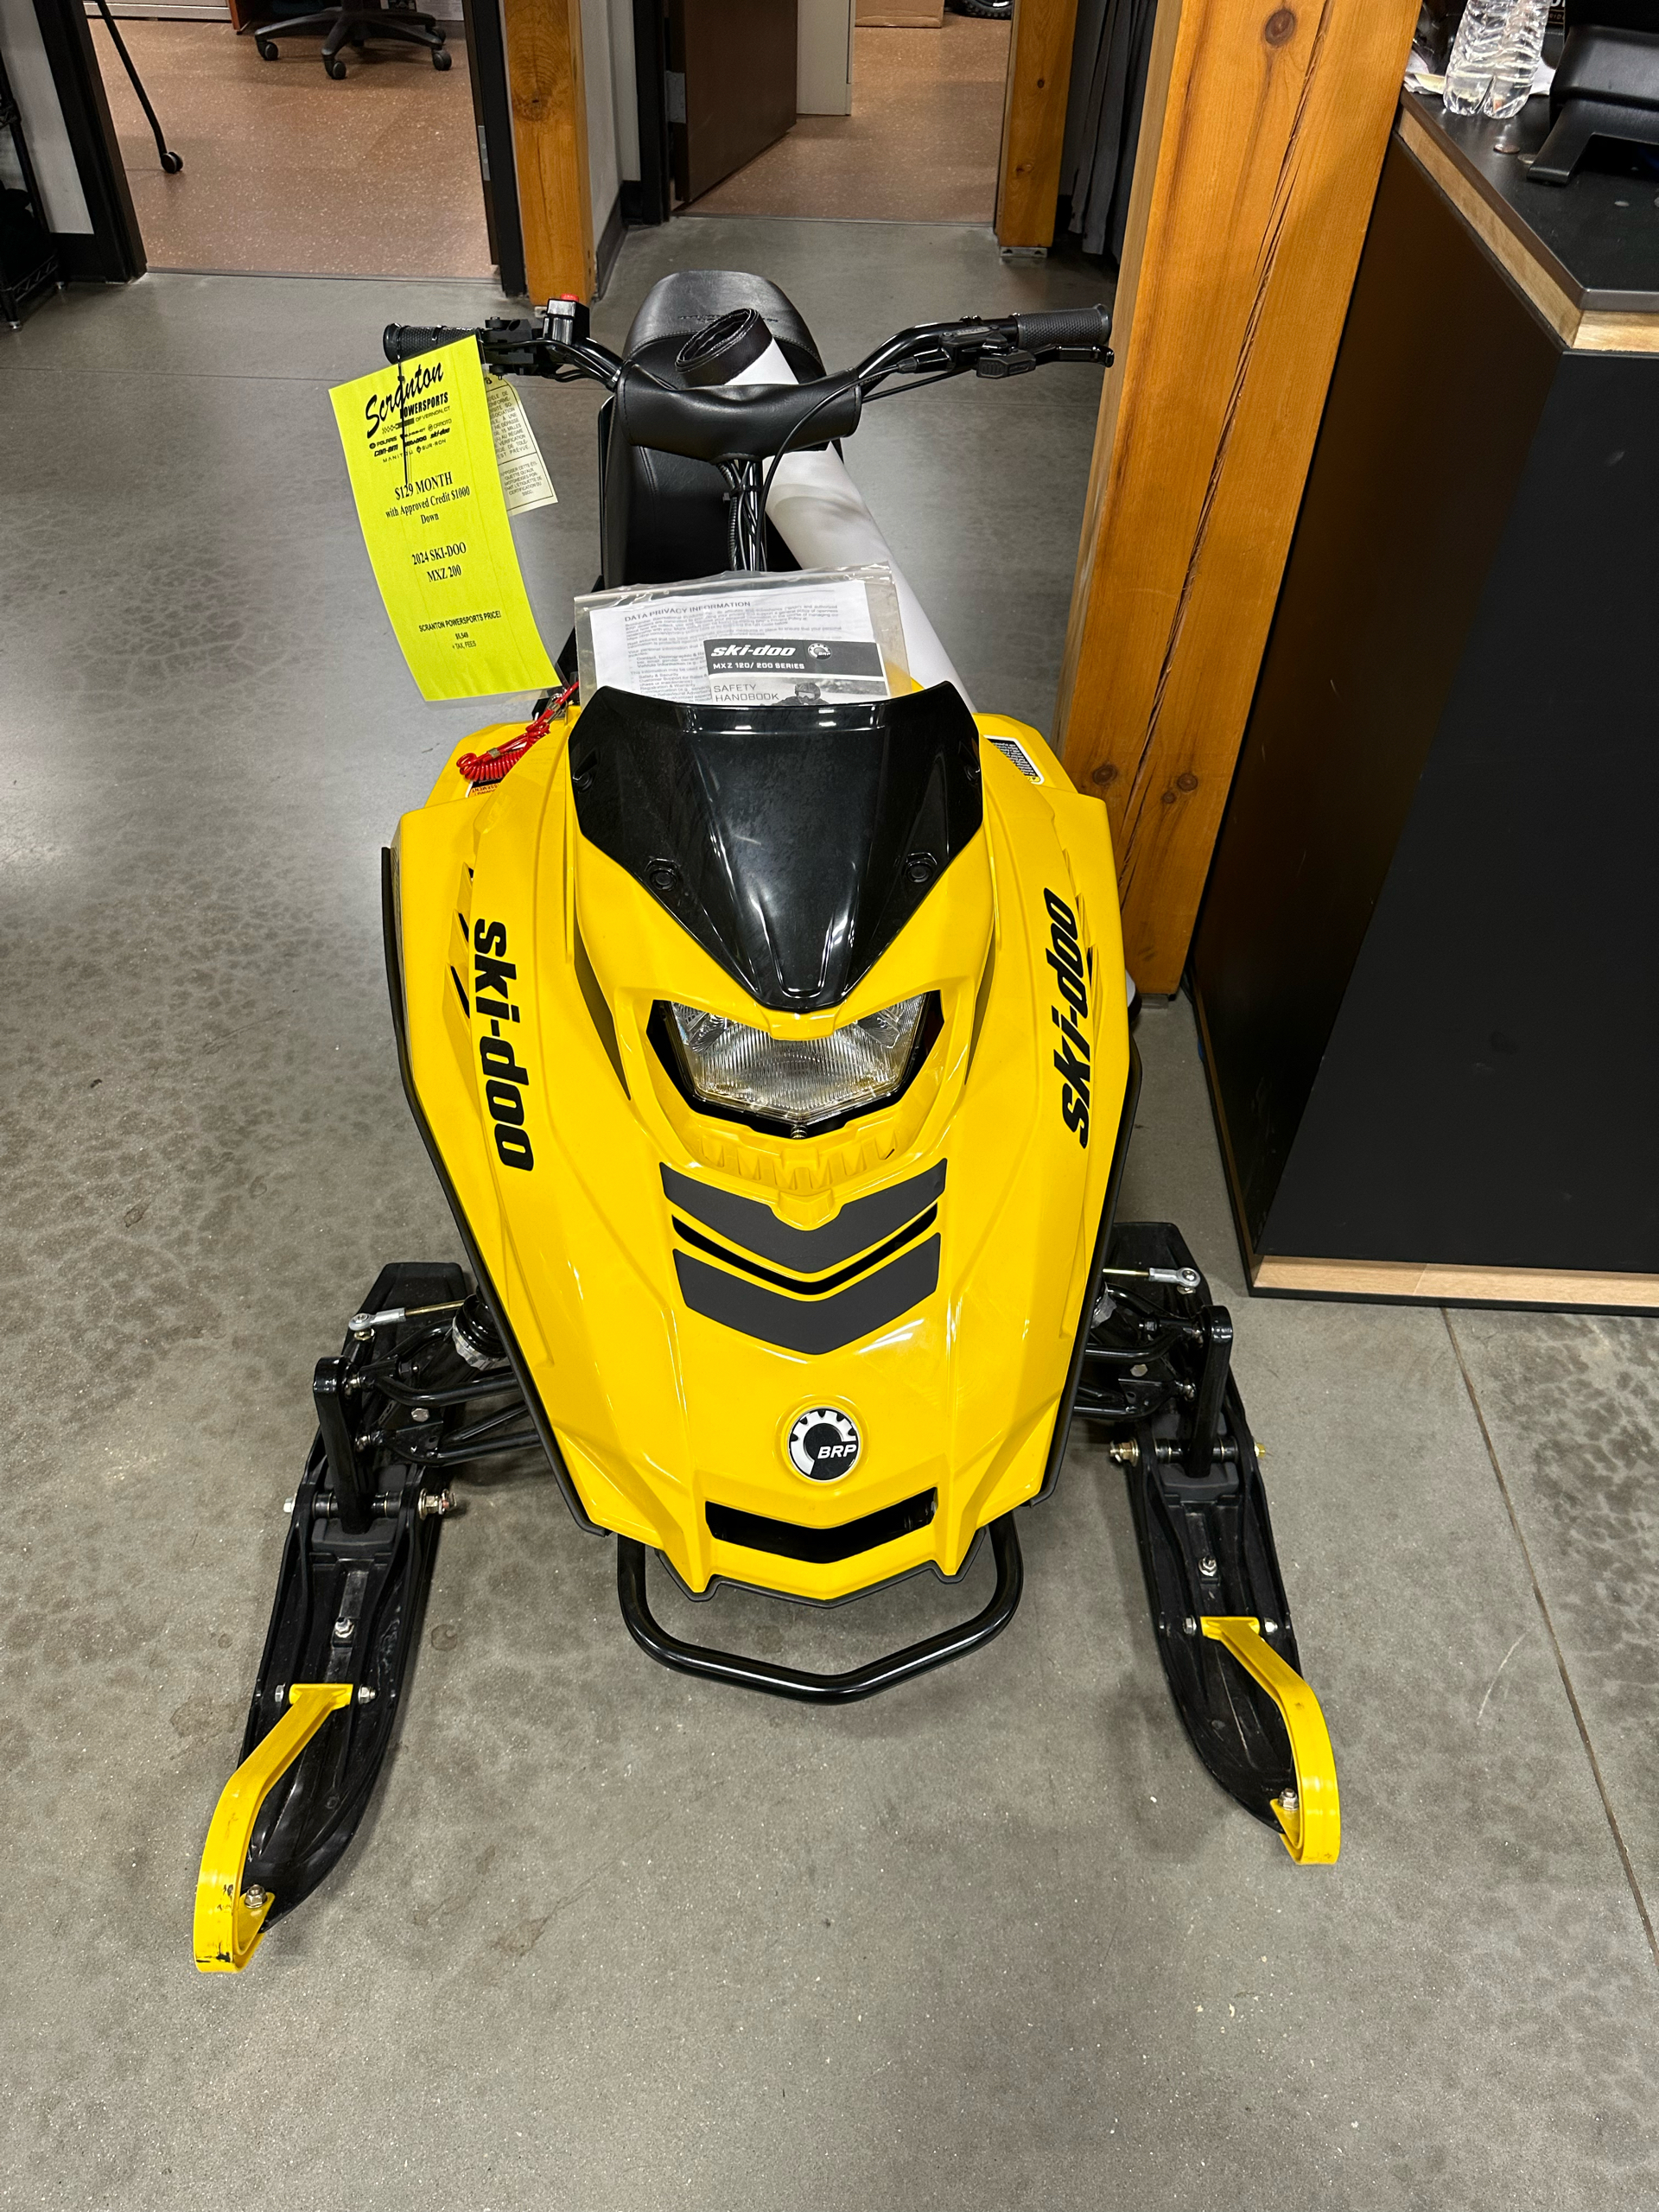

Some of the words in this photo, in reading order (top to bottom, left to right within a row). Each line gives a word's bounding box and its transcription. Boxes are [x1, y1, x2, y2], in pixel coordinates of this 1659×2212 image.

[365, 362, 443, 439] Scranton
[394, 483, 413, 501] $129
[415, 471, 453, 494] MONTH
[385, 507, 399, 518] with
[400, 498, 429, 516] Approved
[430, 493, 450, 506] Credit
[451, 485, 470, 500] $1000
[420, 513, 439, 524] Down
[412, 552, 429, 565] 2024
[430, 542, 467, 561] SKI-DOO
[427, 567, 448, 582] MXZ
[448, 564, 462, 577] 200
[624, 613, 648, 622] DATA
[650, 608, 687, 617] PRIVACY
[690, 601, 750, 613] INFORMATION
[419, 622, 445, 632] SCRANTON
[445, 614, 483, 627] POWERSPORTS
[711, 645, 796, 656] ski-doo
[714, 684, 756, 693] SAFETY
[716, 693, 779, 702] HANDBOOK
[1043, 887, 1090, 1149] ski-doo
[474, 918, 534, 1172] ski-doo
[817, 1444, 857, 1459] BRP
